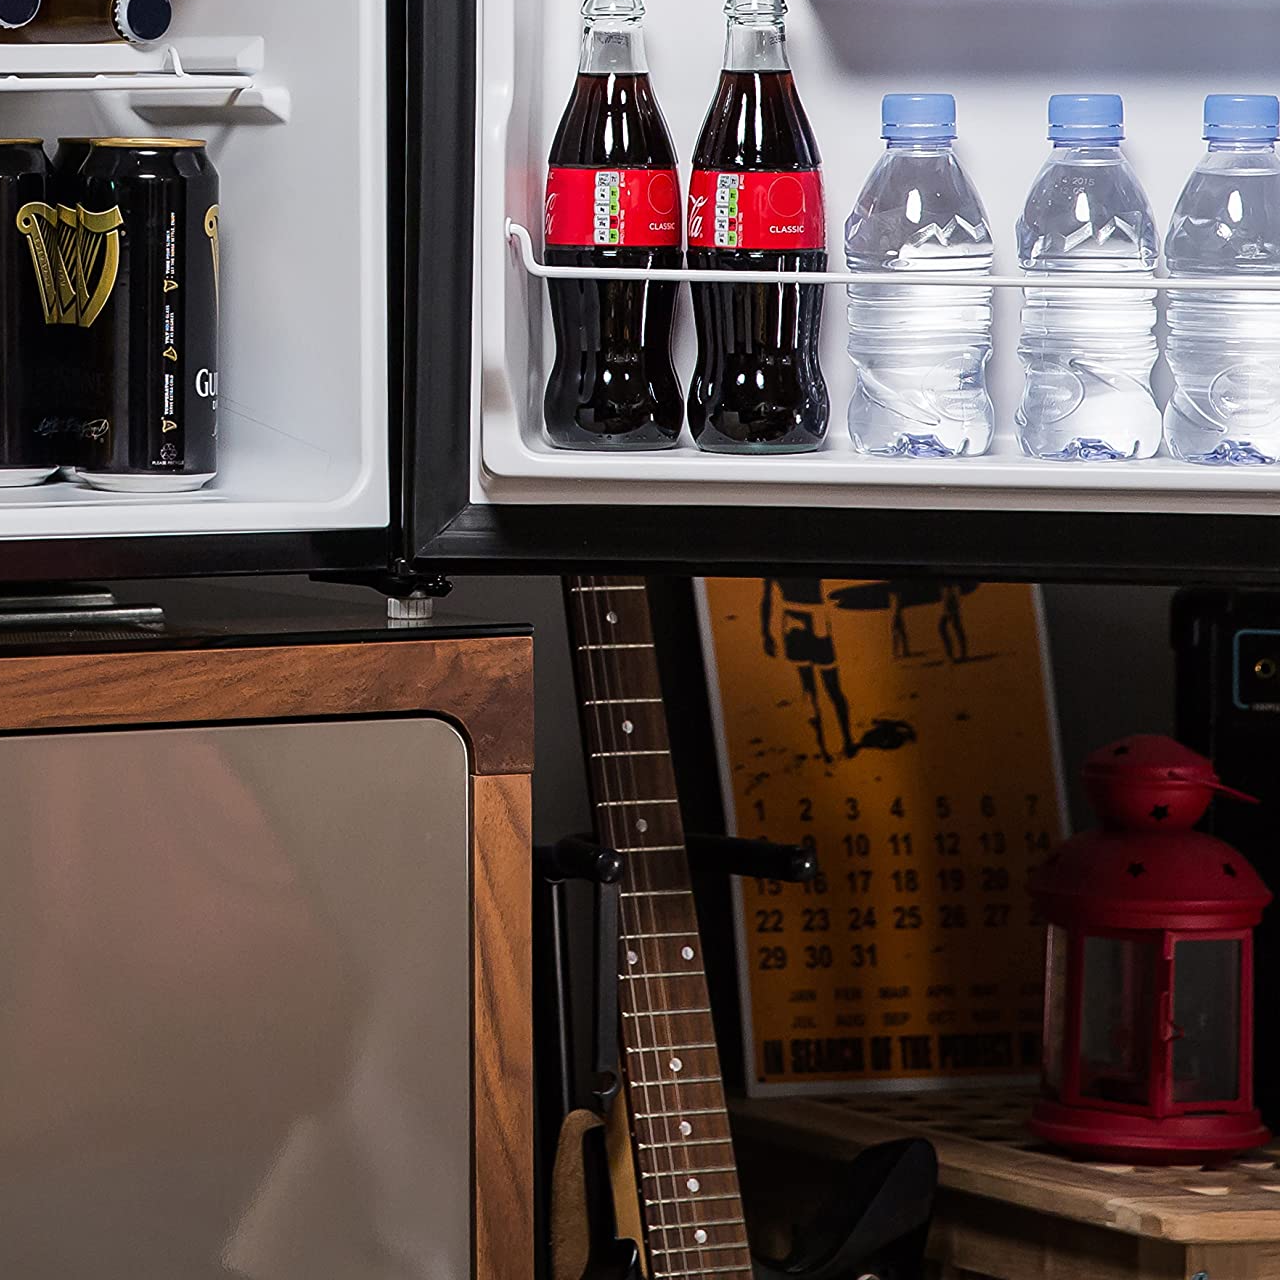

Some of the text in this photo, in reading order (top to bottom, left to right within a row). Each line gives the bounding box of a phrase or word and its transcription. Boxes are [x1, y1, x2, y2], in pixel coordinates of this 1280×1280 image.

[649, 222, 675, 231] CLASSIC
[769, 225, 804, 233] CLASSIC
[754, 794, 1039, 822] 1 2 3 4 5 6 7
[842, 833, 870, 857] 10
[888, 832, 913, 856] 11
[934, 831, 961, 855] 12
[979, 831, 1007, 855] 13
[1024, 830, 1050, 854] 14
[847, 869, 873, 894] 17
[891, 868, 919, 893] 18
[936, 867, 964, 893] 19
[981, 866, 1009, 892] 20
[755, 908, 784, 933] 22
[801, 907, 831, 932] 23
[848, 905, 877, 931] 24
[893, 904, 923, 930] 25
[938, 903, 966, 929] 26
[984, 902, 1012, 928] 27
[758, 942, 878, 970] 29 30 31
